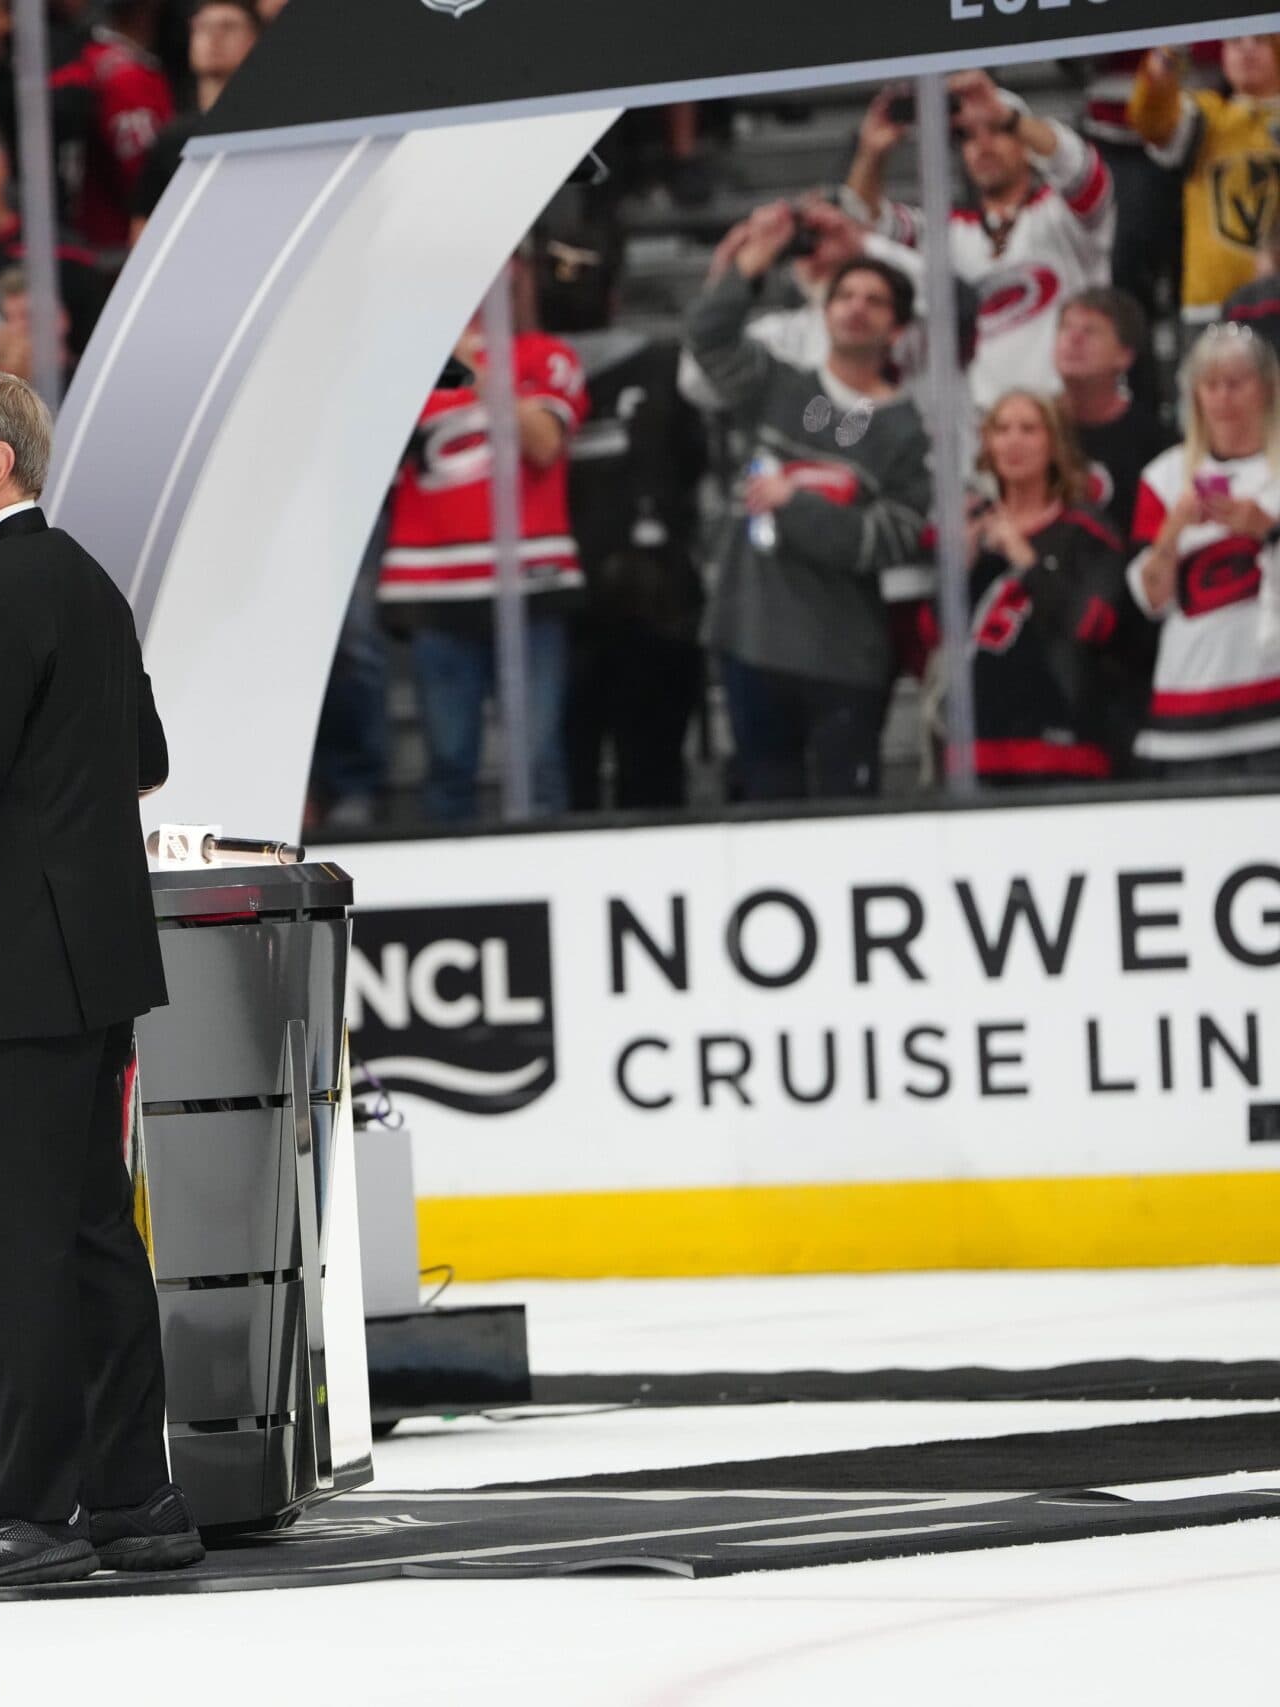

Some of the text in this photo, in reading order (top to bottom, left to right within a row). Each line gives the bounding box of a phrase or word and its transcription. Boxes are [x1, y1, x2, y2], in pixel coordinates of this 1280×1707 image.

[608, 861, 1280, 994] NORWEG
[349, 938, 544, 1030] NCL
[616, 1012, 1260, 1109] CRUISE LIN
